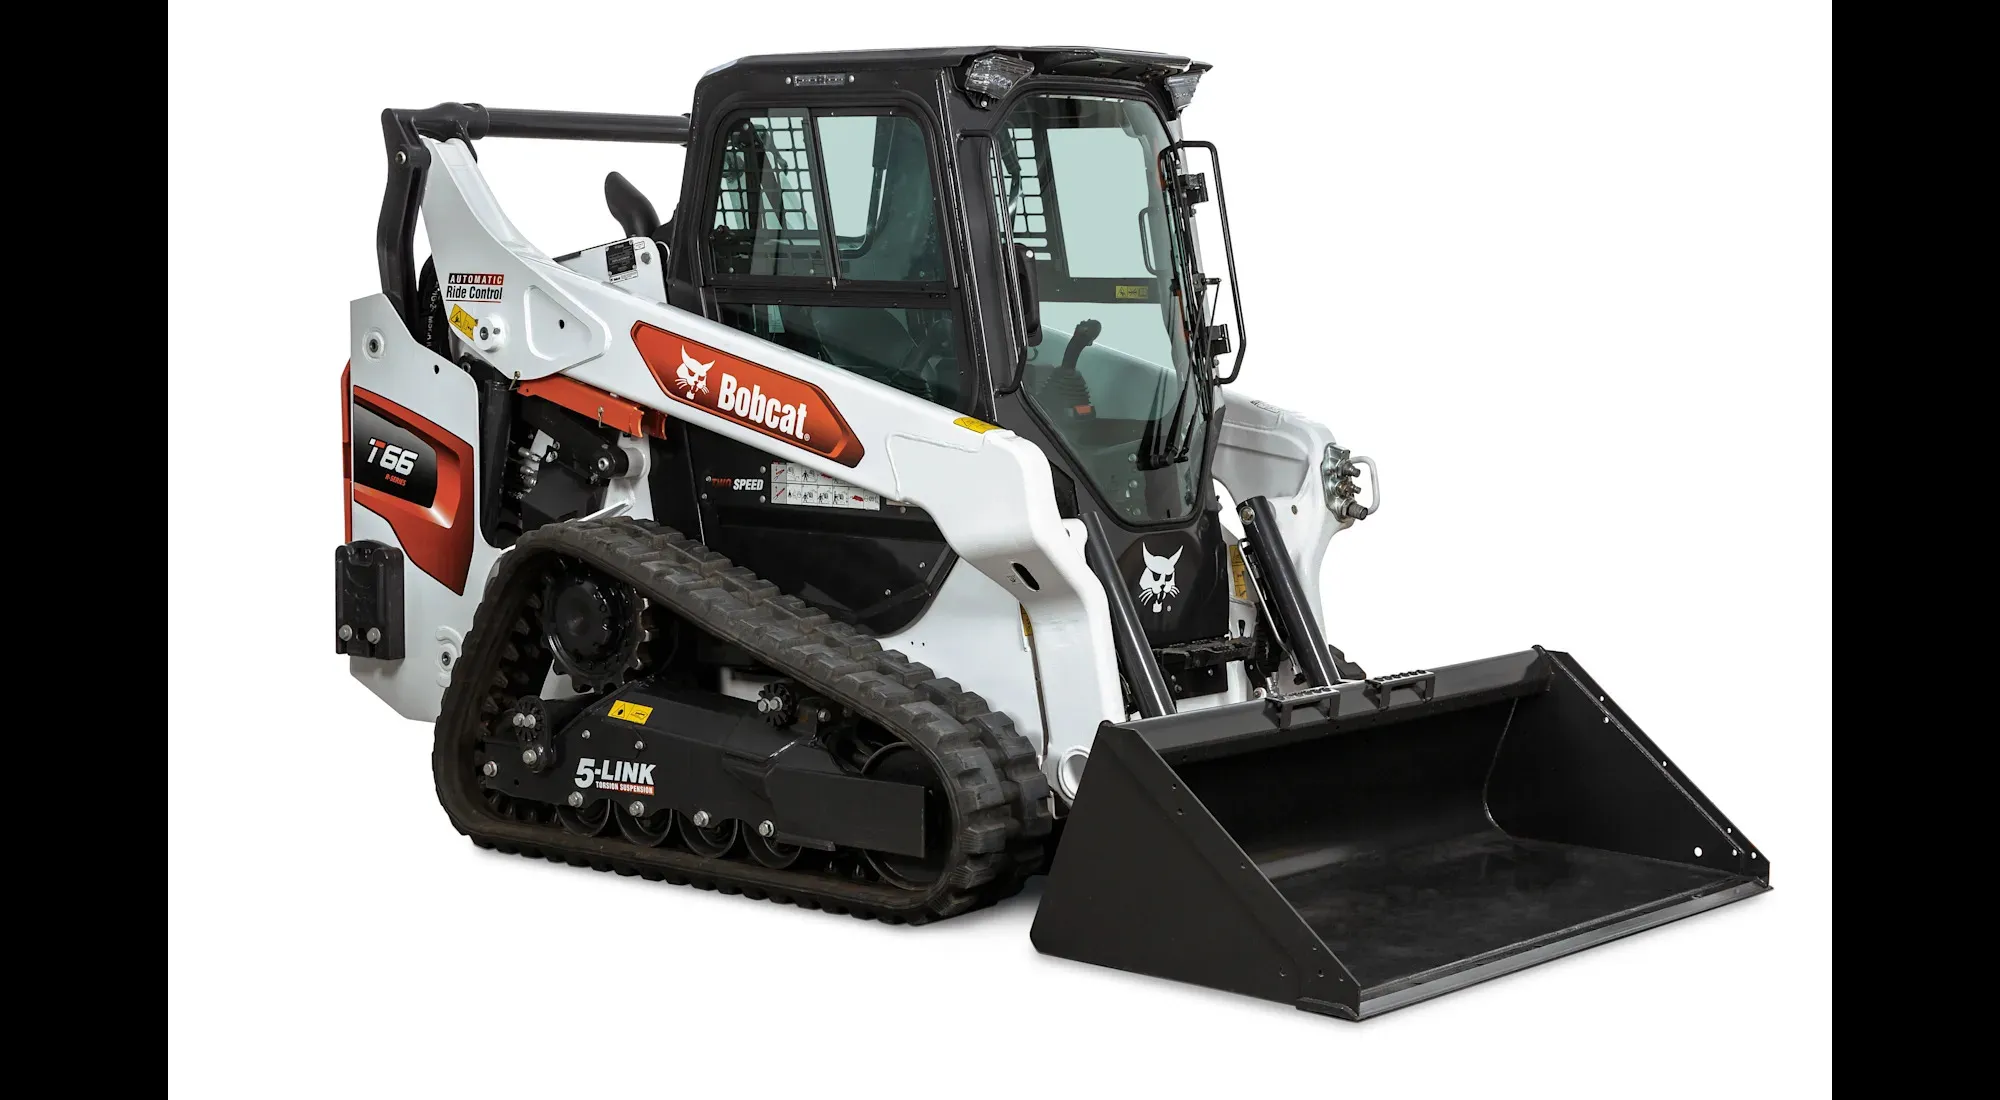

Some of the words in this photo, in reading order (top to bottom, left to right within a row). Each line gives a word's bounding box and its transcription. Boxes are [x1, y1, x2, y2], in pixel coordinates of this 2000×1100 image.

[449, 274, 503, 284] AUTOMATIC
[446, 285, 467, 298] Ride
[469, 285, 503, 300] Control
[367, 438, 419, 476] T66
[711, 478, 732, 489] TWO
[733, 478, 764, 491] SPEED
[574, 758, 657, 788] 5-LINK
[596, 781, 619, 791] TORSION
[619, 783, 654, 795] SUSPENSION
